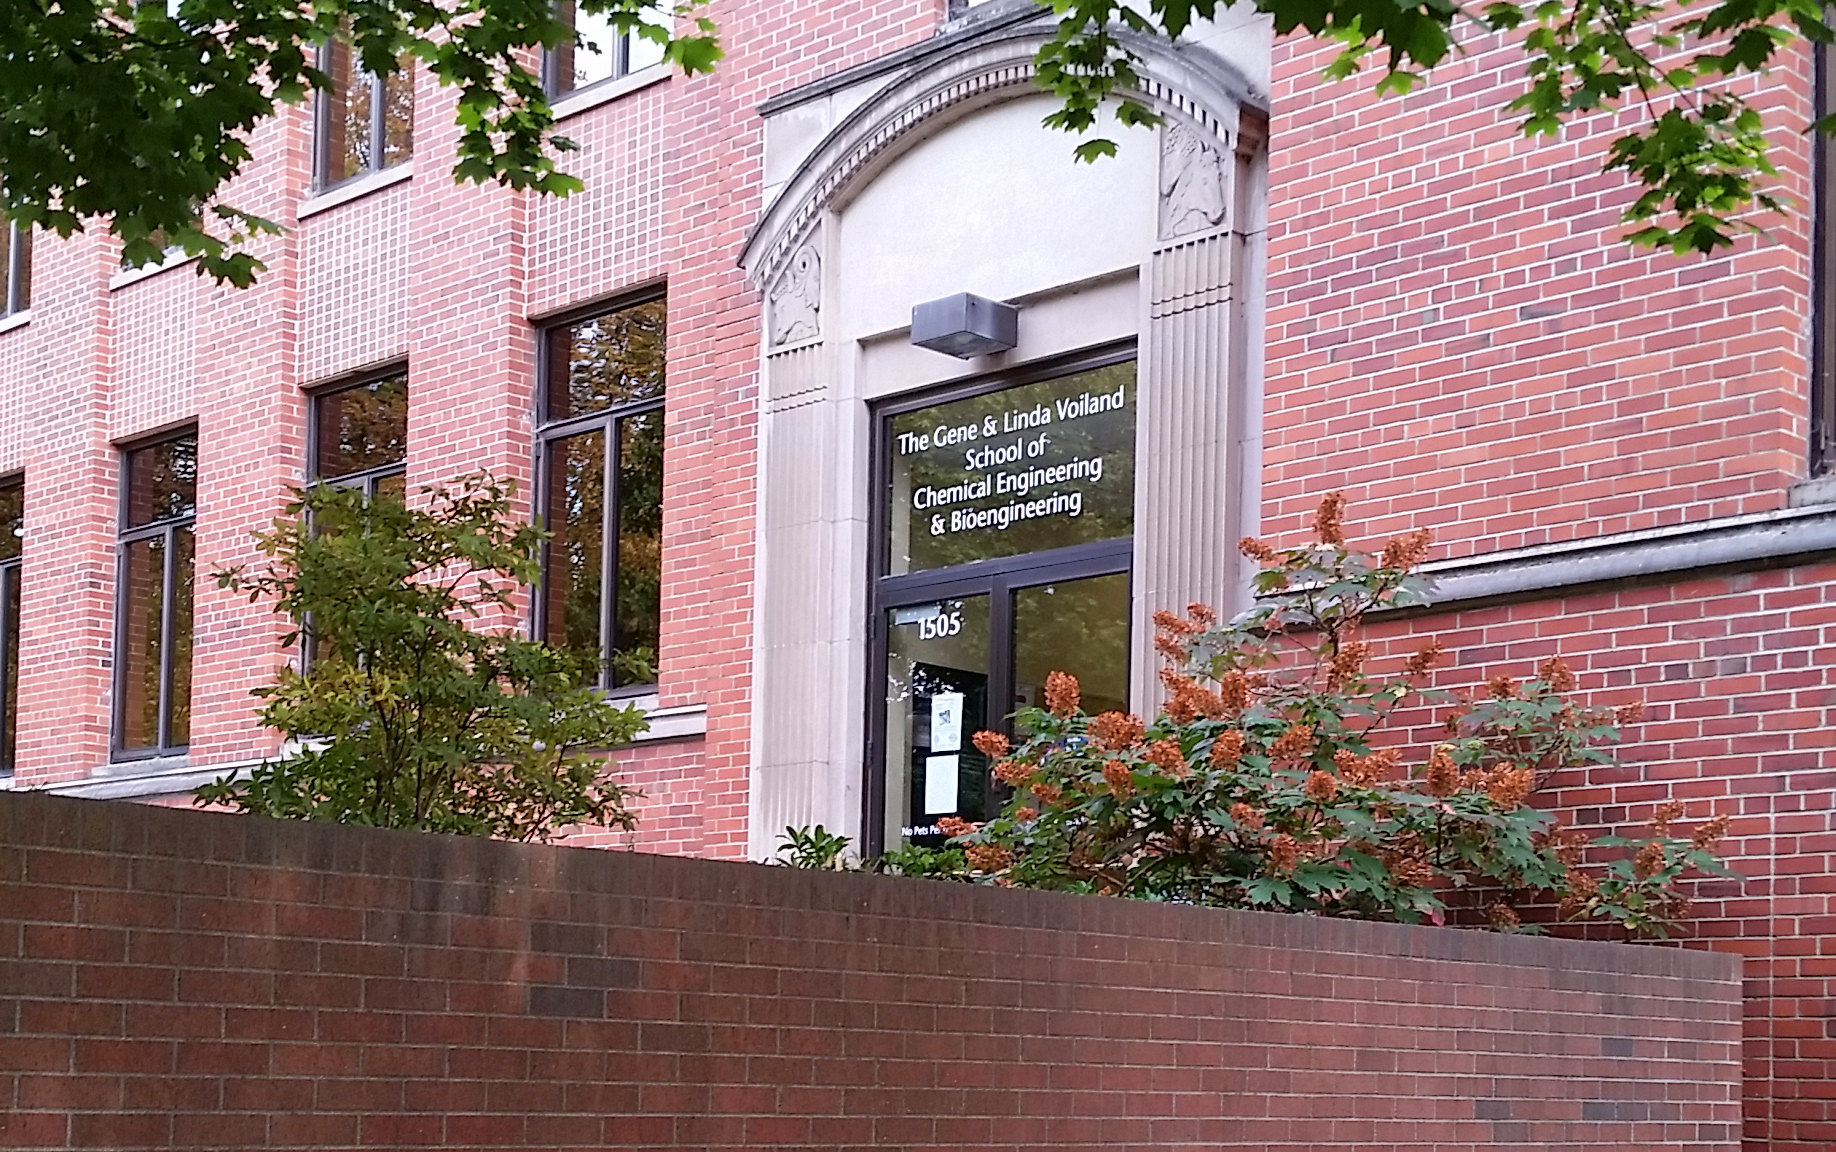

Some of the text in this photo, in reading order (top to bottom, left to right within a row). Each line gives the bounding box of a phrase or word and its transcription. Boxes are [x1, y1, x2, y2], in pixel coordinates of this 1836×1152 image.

[898, 385, 1125, 455] The Gene & Linda Voiland
[965, 433, 1048, 471] School of
[914, 457, 1103, 510] Chemical Engineering
[930, 491, 1082, 536] & Bioengineering
[918, 611, 961, 640] 1505
[901, 826, 913, 836] No
[914, 825, 928, 836] Pets
